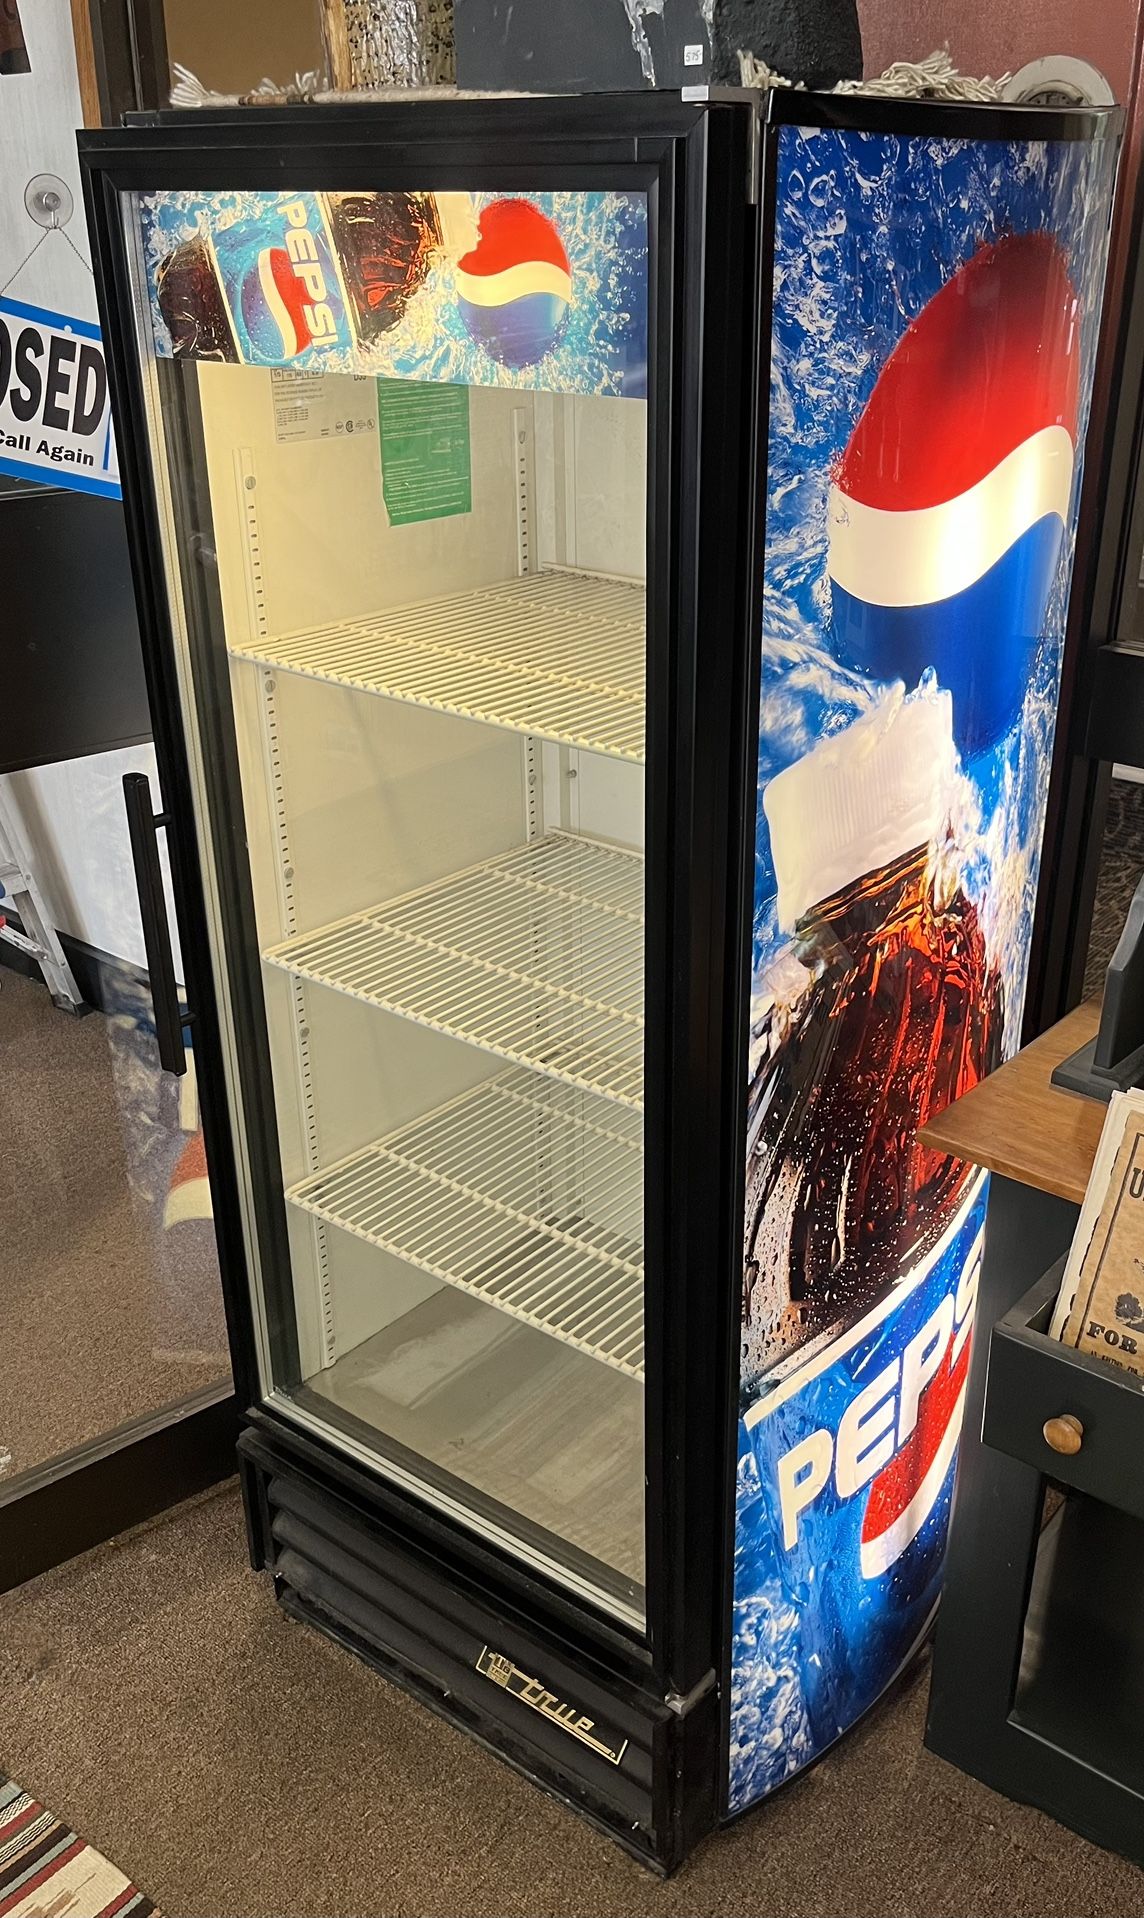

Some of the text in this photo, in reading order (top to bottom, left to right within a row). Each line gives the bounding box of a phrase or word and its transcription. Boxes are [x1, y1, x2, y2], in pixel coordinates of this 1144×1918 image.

[277, 201, 338, 346] PEPSI
[36, 440, 94, 466] Again
[1086, 1321, 1137, 1355] FOR
